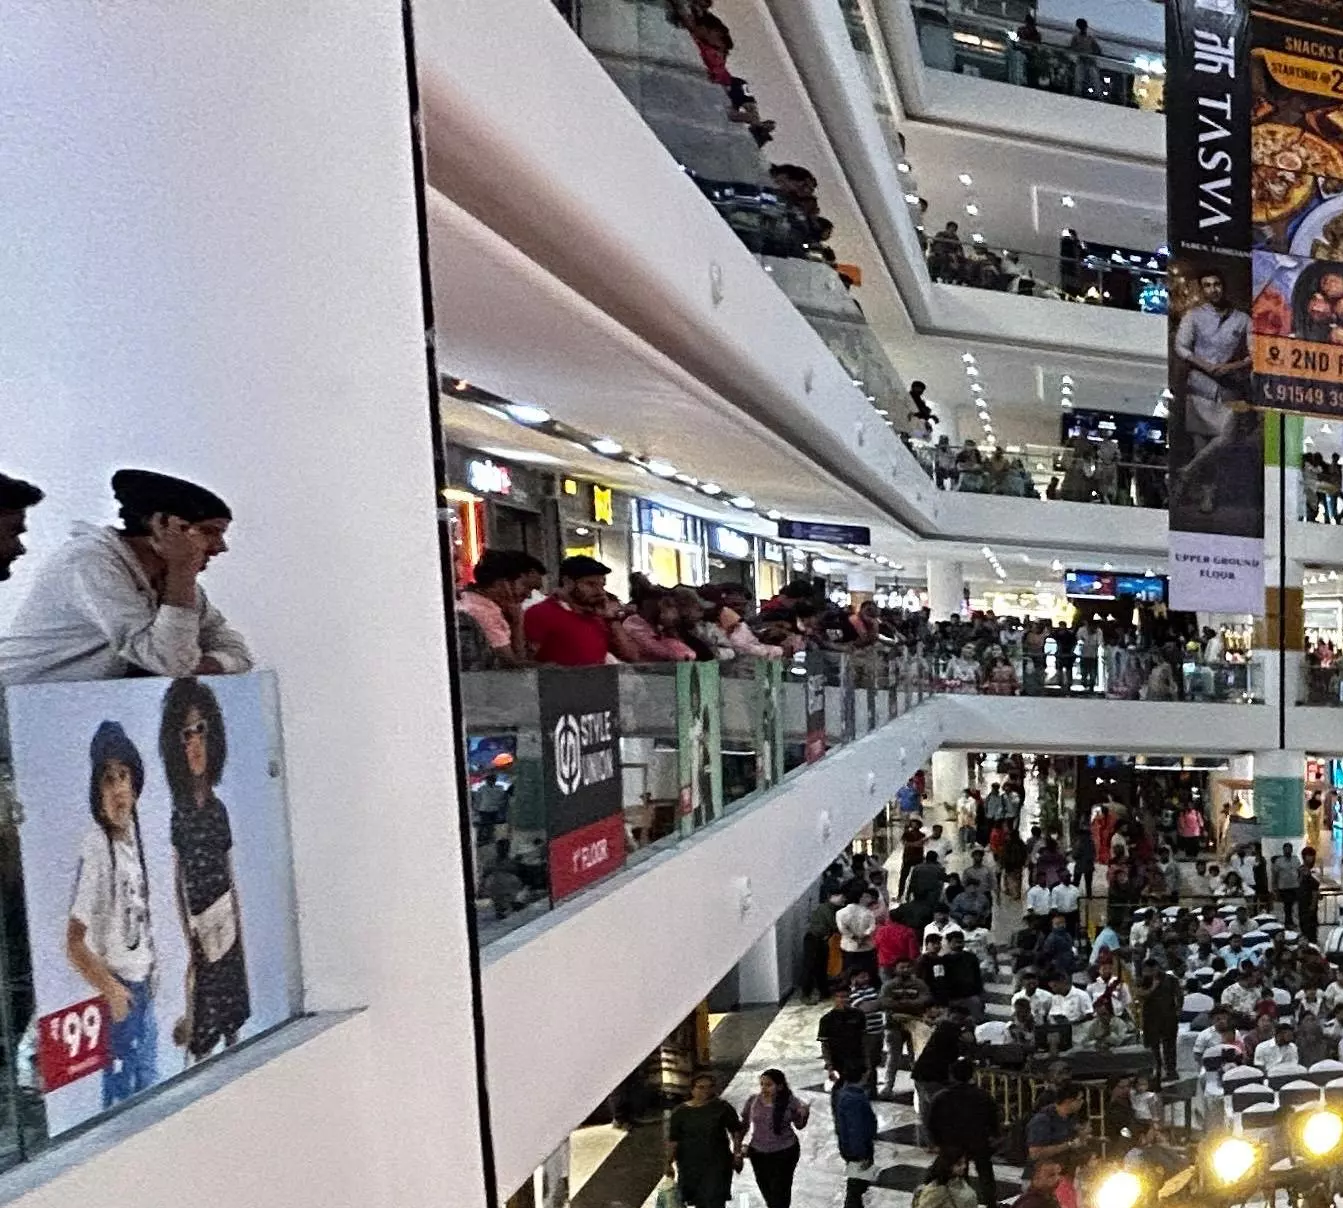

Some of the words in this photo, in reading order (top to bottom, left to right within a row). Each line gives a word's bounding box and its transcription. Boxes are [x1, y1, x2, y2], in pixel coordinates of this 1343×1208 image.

[1285, 36, 1335, 60] SNACKS
[1198, 93, 1232, 228] TASVA
[1292, 348, 1329, 373] 2ND
[1276, 386, 1323, 406] 91549
